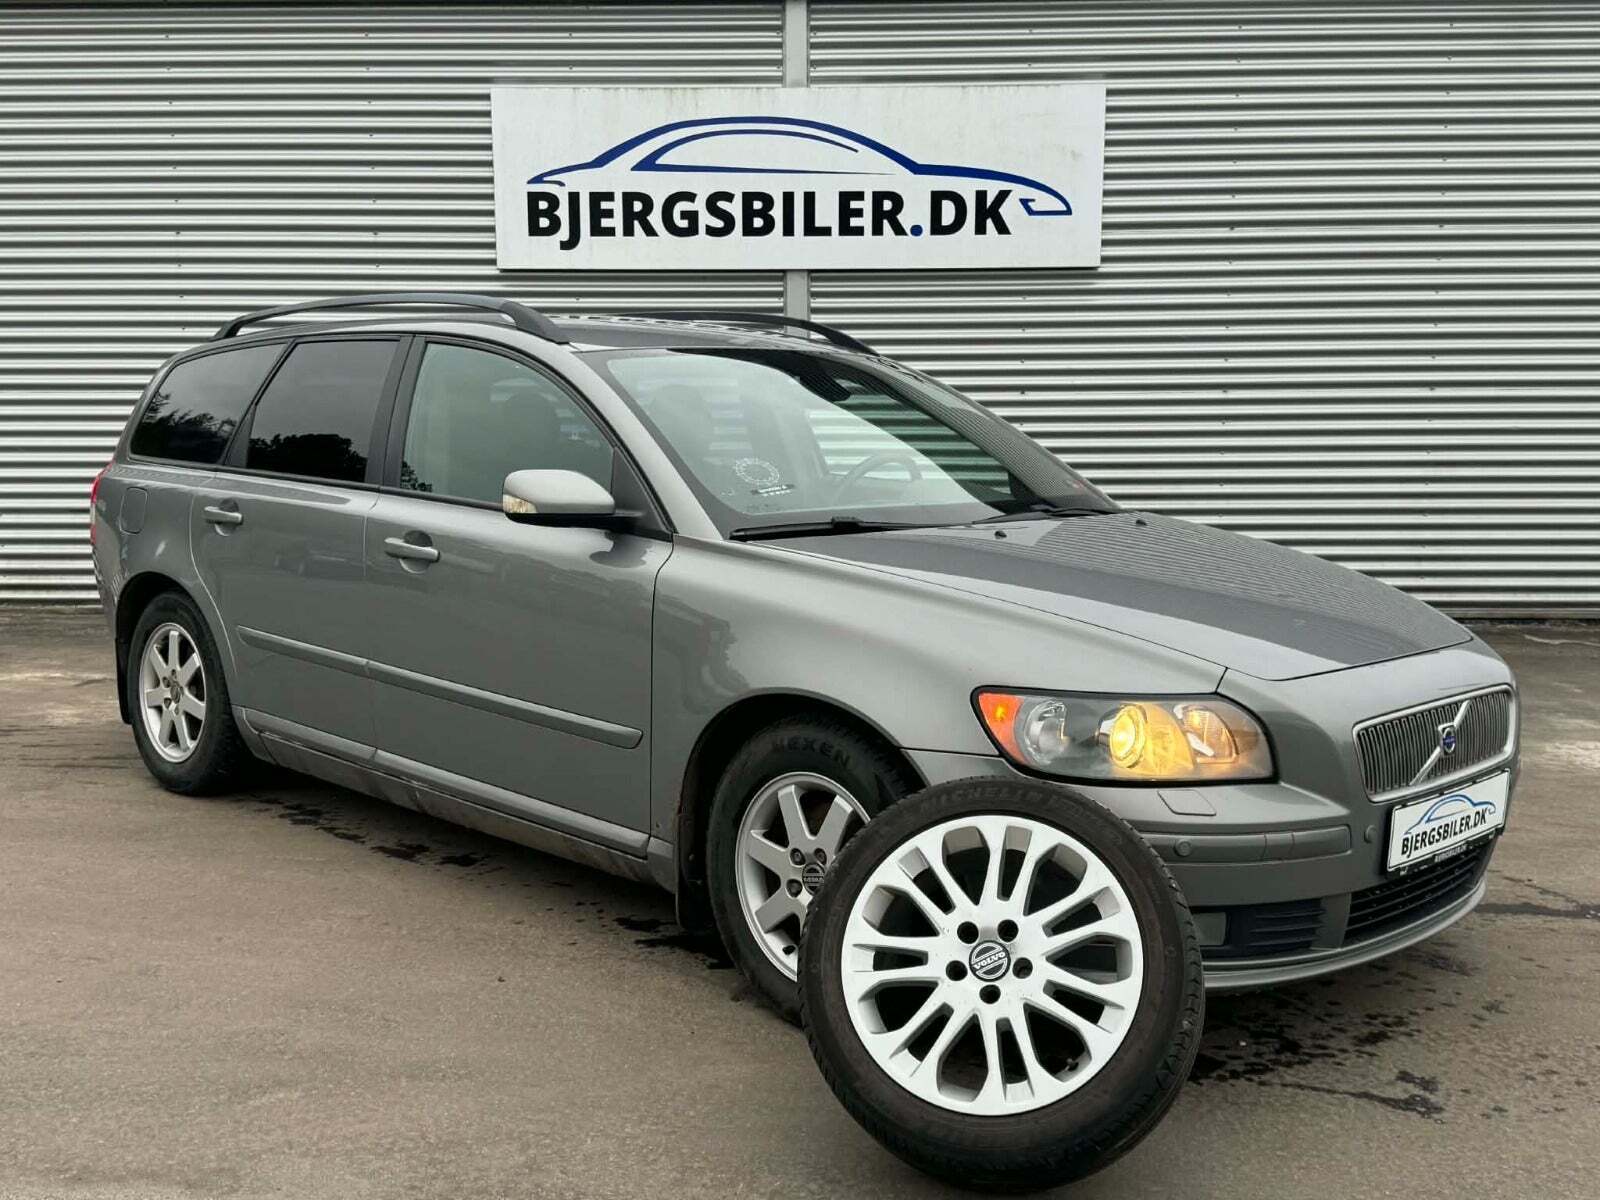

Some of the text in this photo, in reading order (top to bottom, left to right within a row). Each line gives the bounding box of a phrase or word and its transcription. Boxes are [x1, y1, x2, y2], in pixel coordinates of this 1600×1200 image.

[527, 190, 1013, 250] BJERGSBILER.DK
[1401, 808, 1488, 859] BJERGSBILER.DK
[973, 951, 1006, 969] VOLVO
